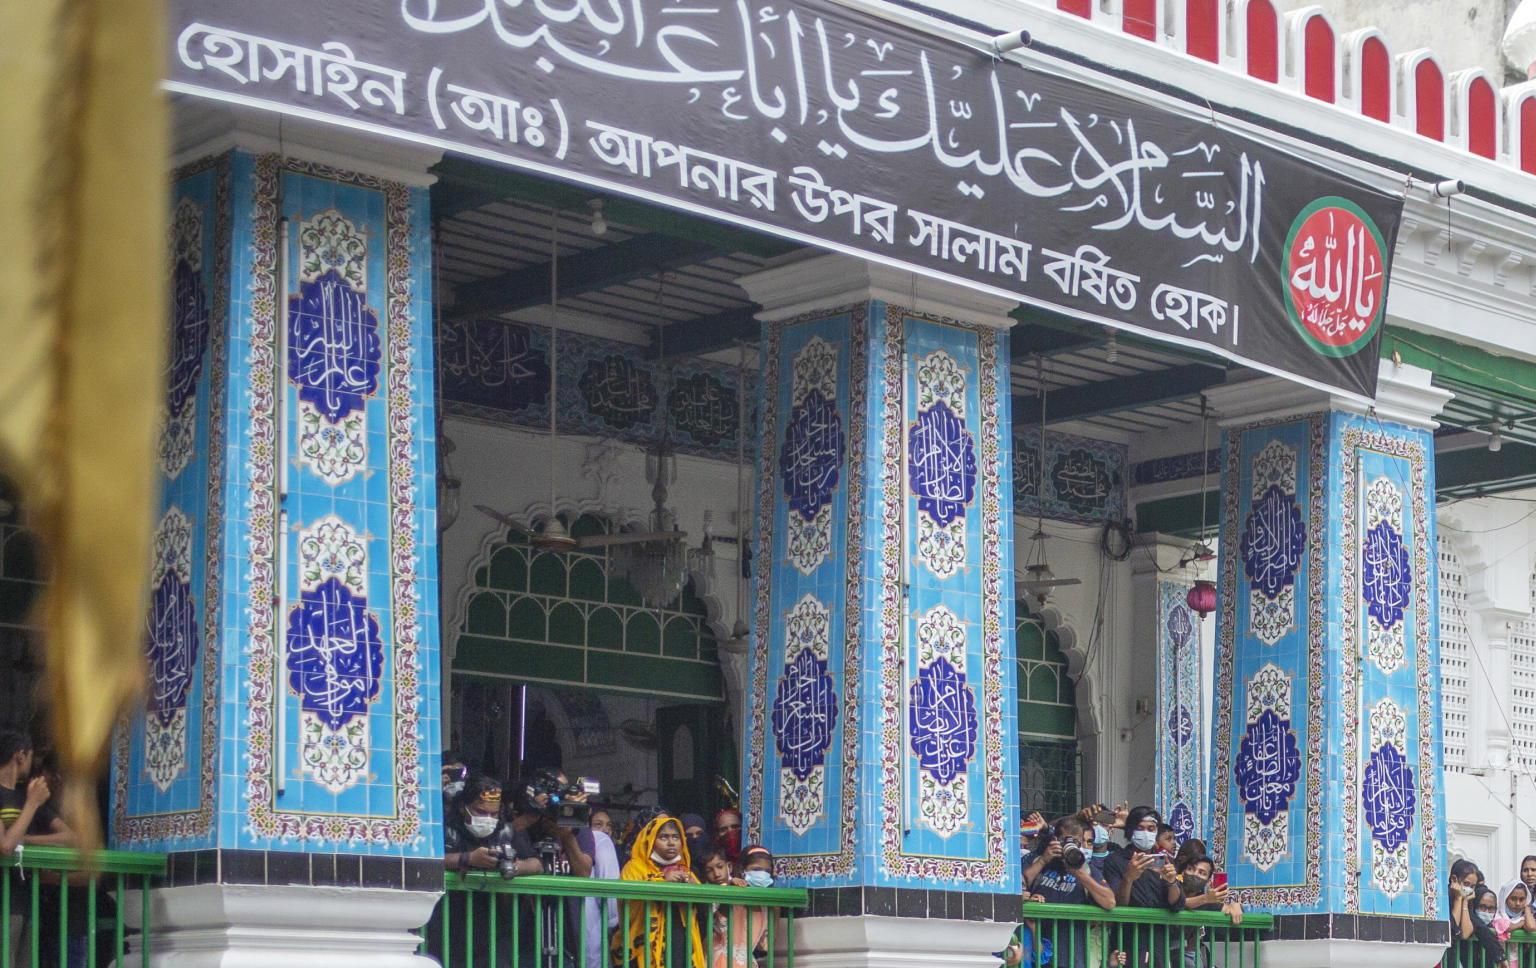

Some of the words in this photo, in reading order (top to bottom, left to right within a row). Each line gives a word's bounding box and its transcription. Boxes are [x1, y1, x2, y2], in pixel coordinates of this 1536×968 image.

[177, 22, 406, 115] হোসাইন
[427, 66, 569, 160] (আঃ)
[586, 119, 777, 213] আপনার
[788, 165, 897, 246] উপর
[907, 206, 1031, 283] সালাম
[1041, 243, 1141, 314] বর্ষিত
